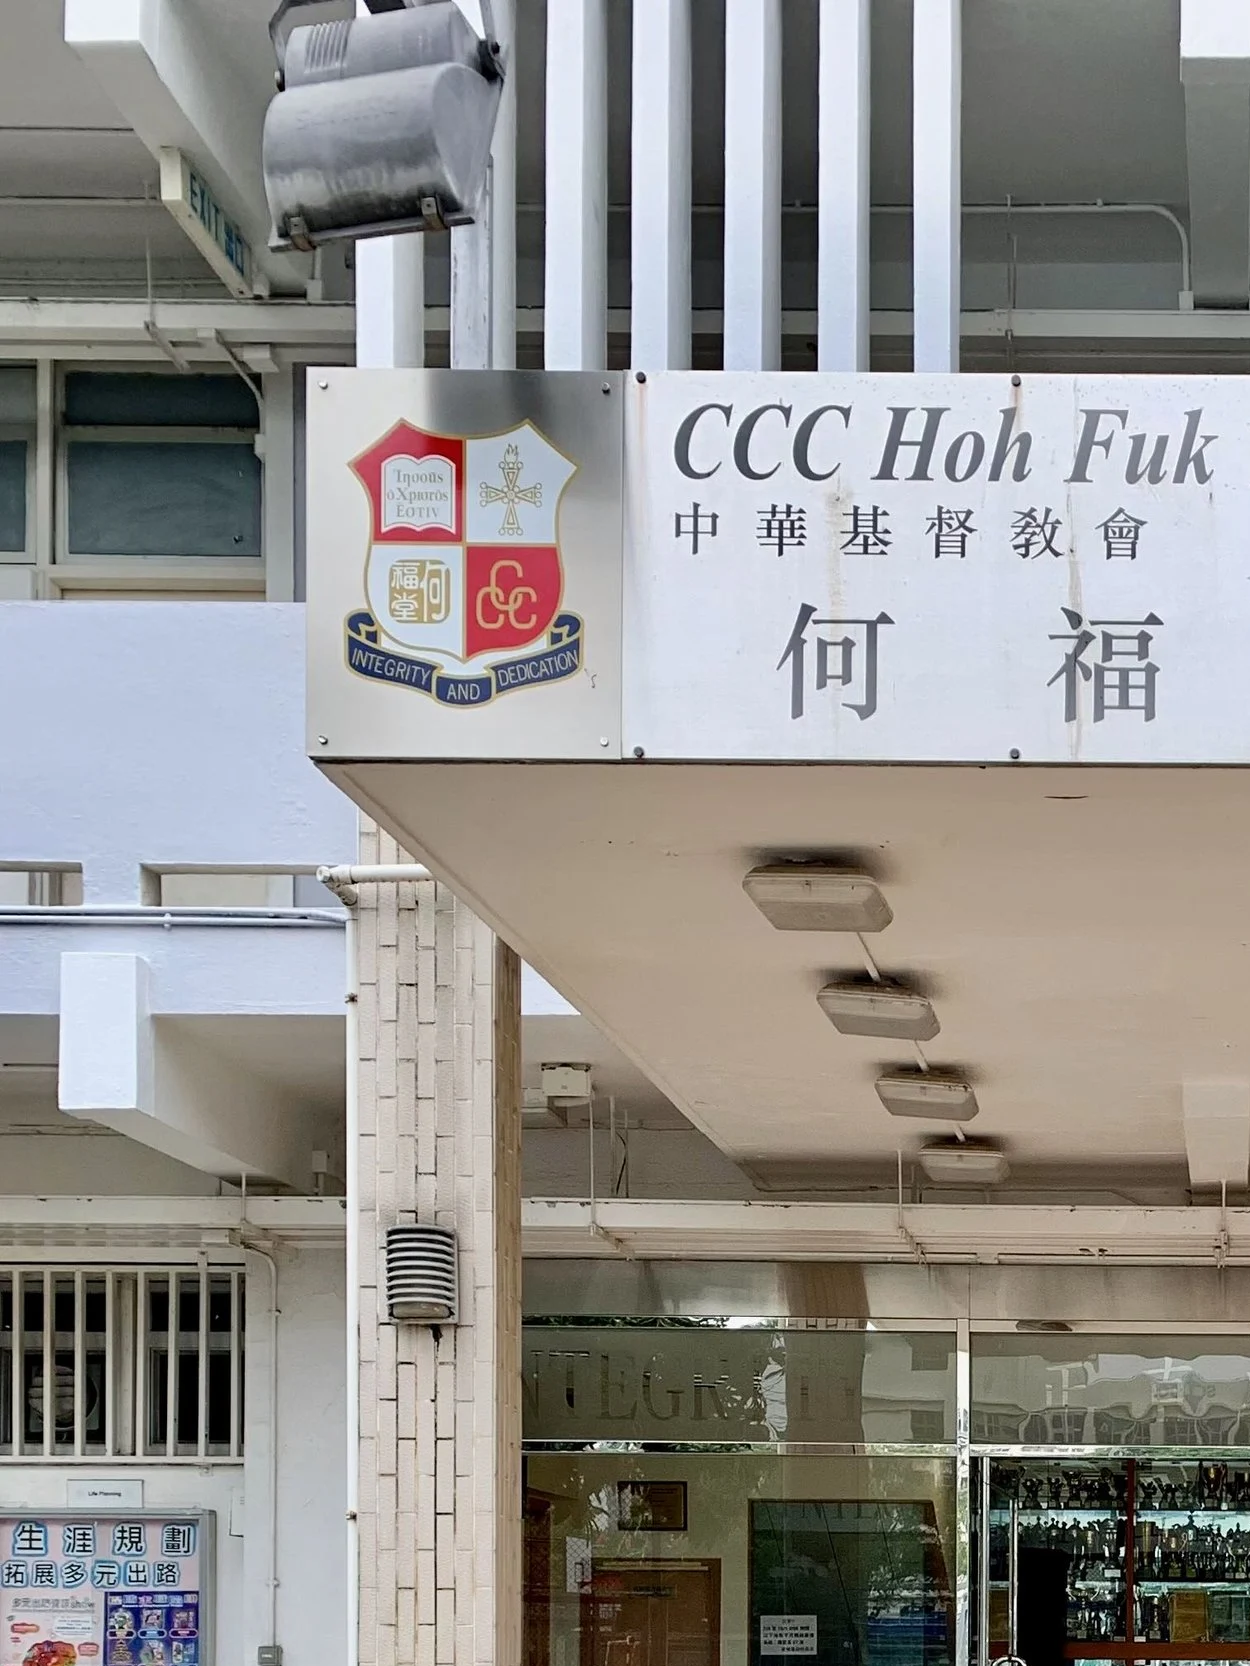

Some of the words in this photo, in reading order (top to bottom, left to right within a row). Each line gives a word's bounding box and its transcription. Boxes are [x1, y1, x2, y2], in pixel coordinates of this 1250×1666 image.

[190, 172, 219, 242] EXIT
[674, 403, 853, 482] CCC
[869, 405, 1033, 483] Hoh
[1062, 408, 1219, 486] Fuk
[351, 648, 431, 685] INTEGRITY
[447, 682, 481, 700] AND
[497, 650, 579, 688] DEDICATION
[16, 1524, 192, 1554] 生涯規劃
[4, 1563, 178, 1586] 拓展多元出路
